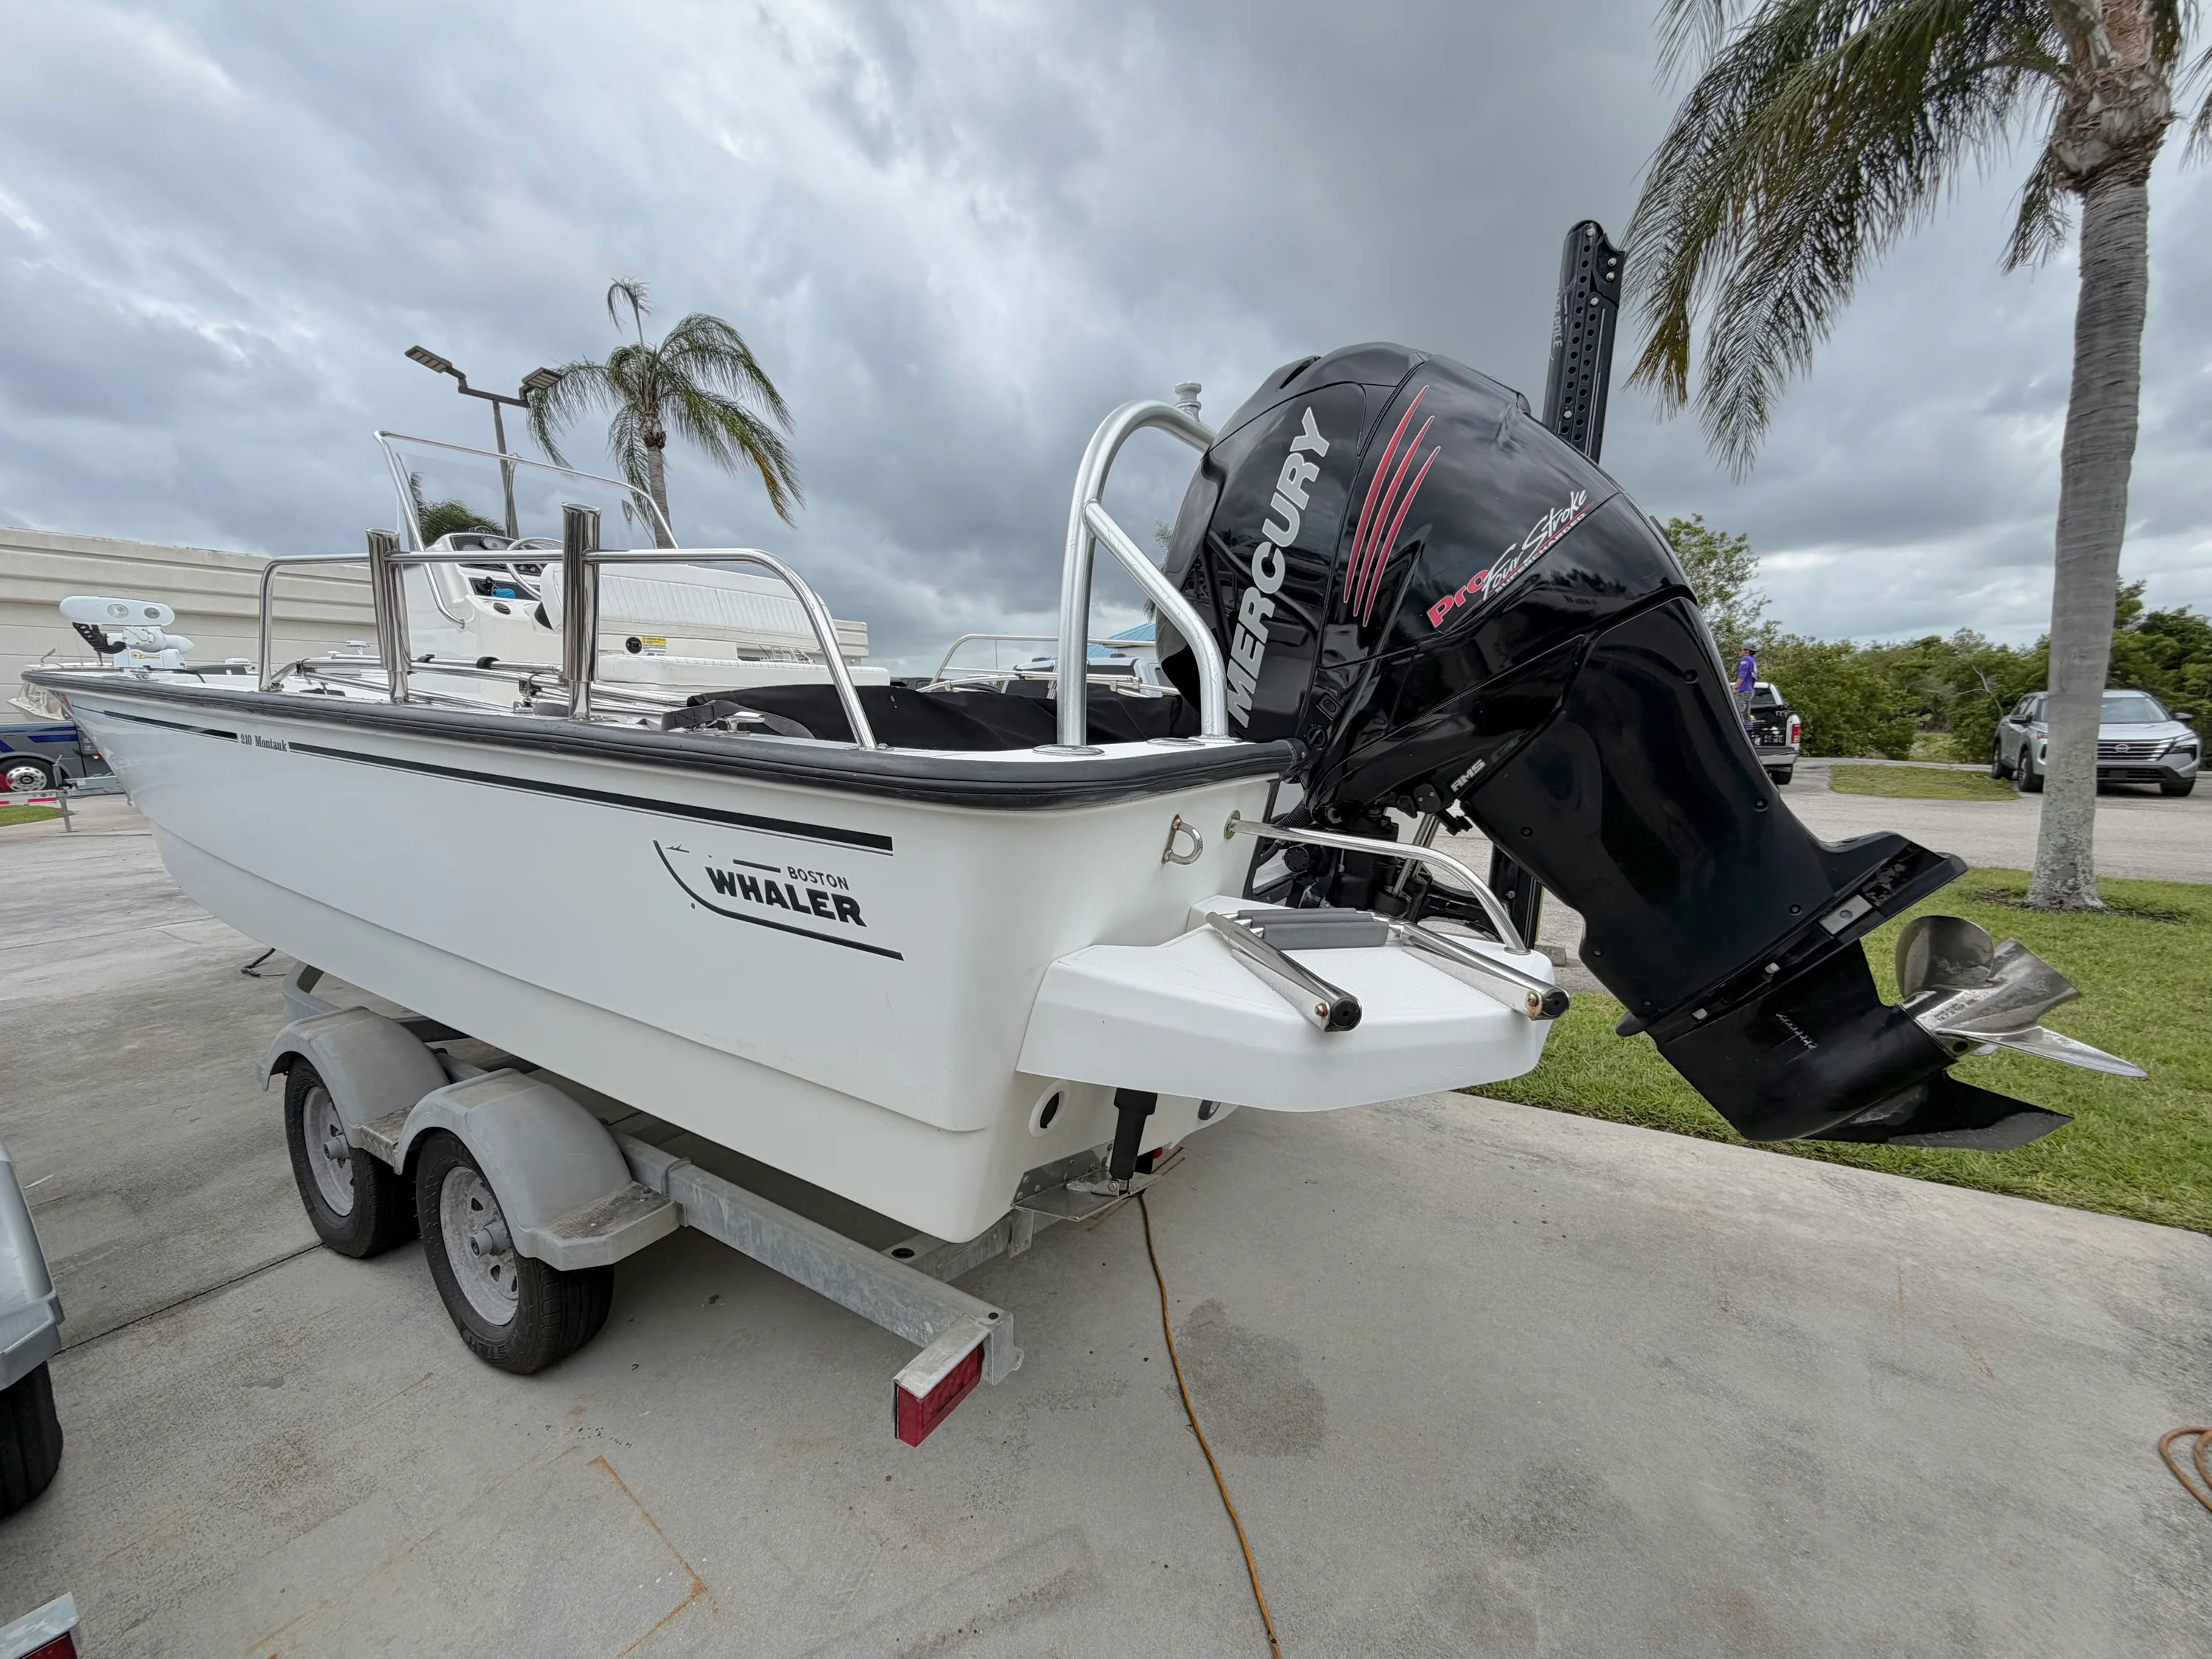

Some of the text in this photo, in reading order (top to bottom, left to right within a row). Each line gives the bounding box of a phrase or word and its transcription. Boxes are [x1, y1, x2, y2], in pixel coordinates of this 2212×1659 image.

[1227, 406, 1329, 728] MERCURY
[240, 734, 288, 752] 210 Montauk
[1450, 758, 1486, 793] AMS
[787, 866, 849, 891] BOSTON
[704, 866, 867, 928] WHALER
